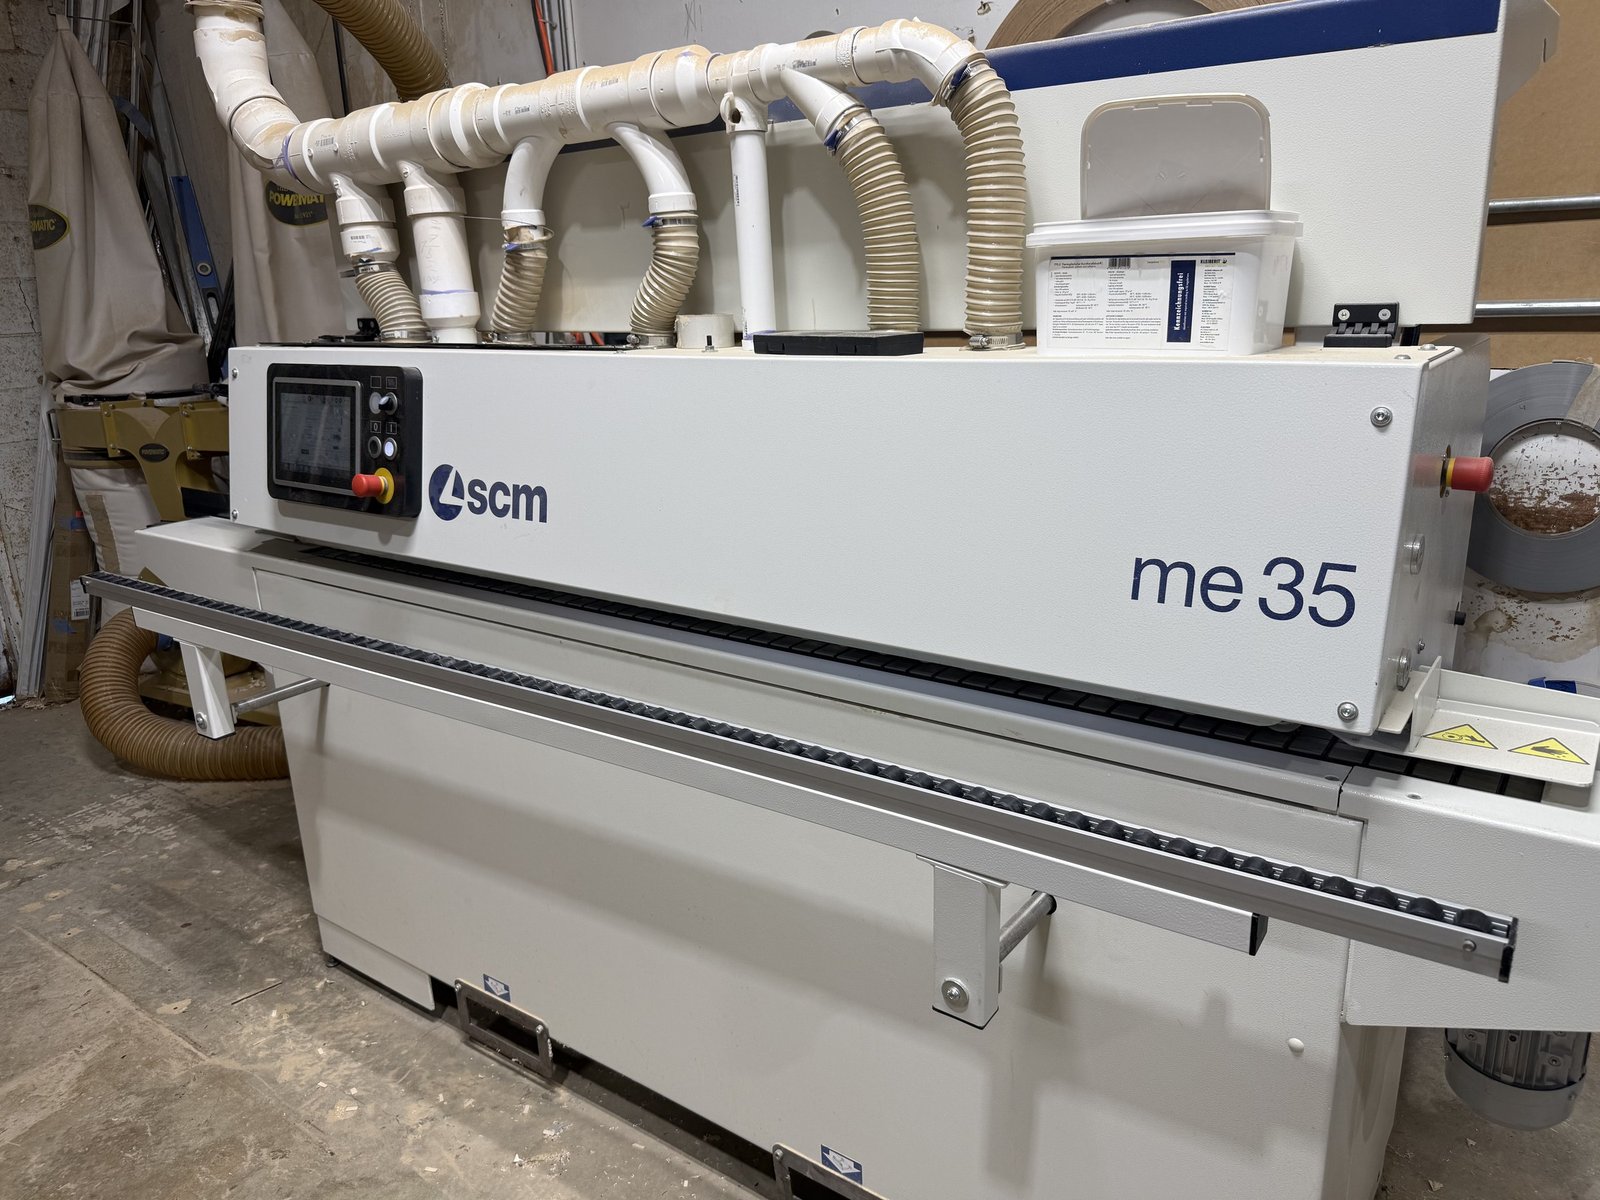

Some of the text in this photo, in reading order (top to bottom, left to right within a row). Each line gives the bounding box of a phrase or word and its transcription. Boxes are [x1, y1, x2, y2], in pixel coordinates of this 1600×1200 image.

[467, 478, 548, 523] scm
[1131, 556, 1357, 627] me 35
